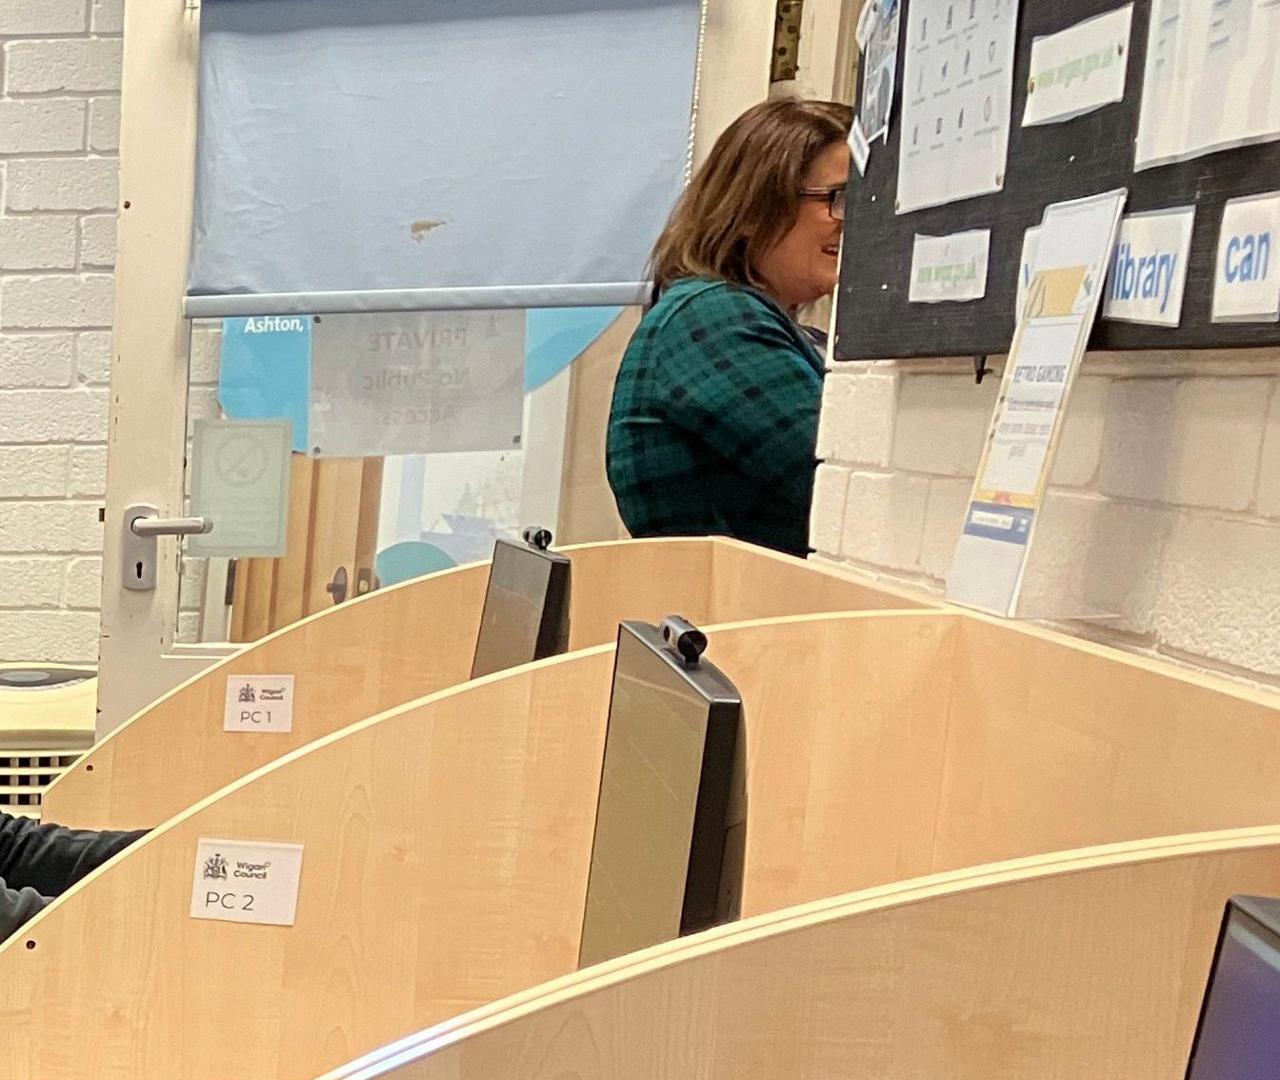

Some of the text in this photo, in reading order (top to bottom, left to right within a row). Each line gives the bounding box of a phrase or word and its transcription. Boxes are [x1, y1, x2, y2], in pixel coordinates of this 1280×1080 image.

[1110, 231, 1271, 314] library can
[244, 315, 306, 335] Ashton,
[240, 711, 272, 724] PC 1
[236, 861, 266, 872] Wigan
[233, 870, 268, 880] Council
[205, 891, 255, 911] PC 2
